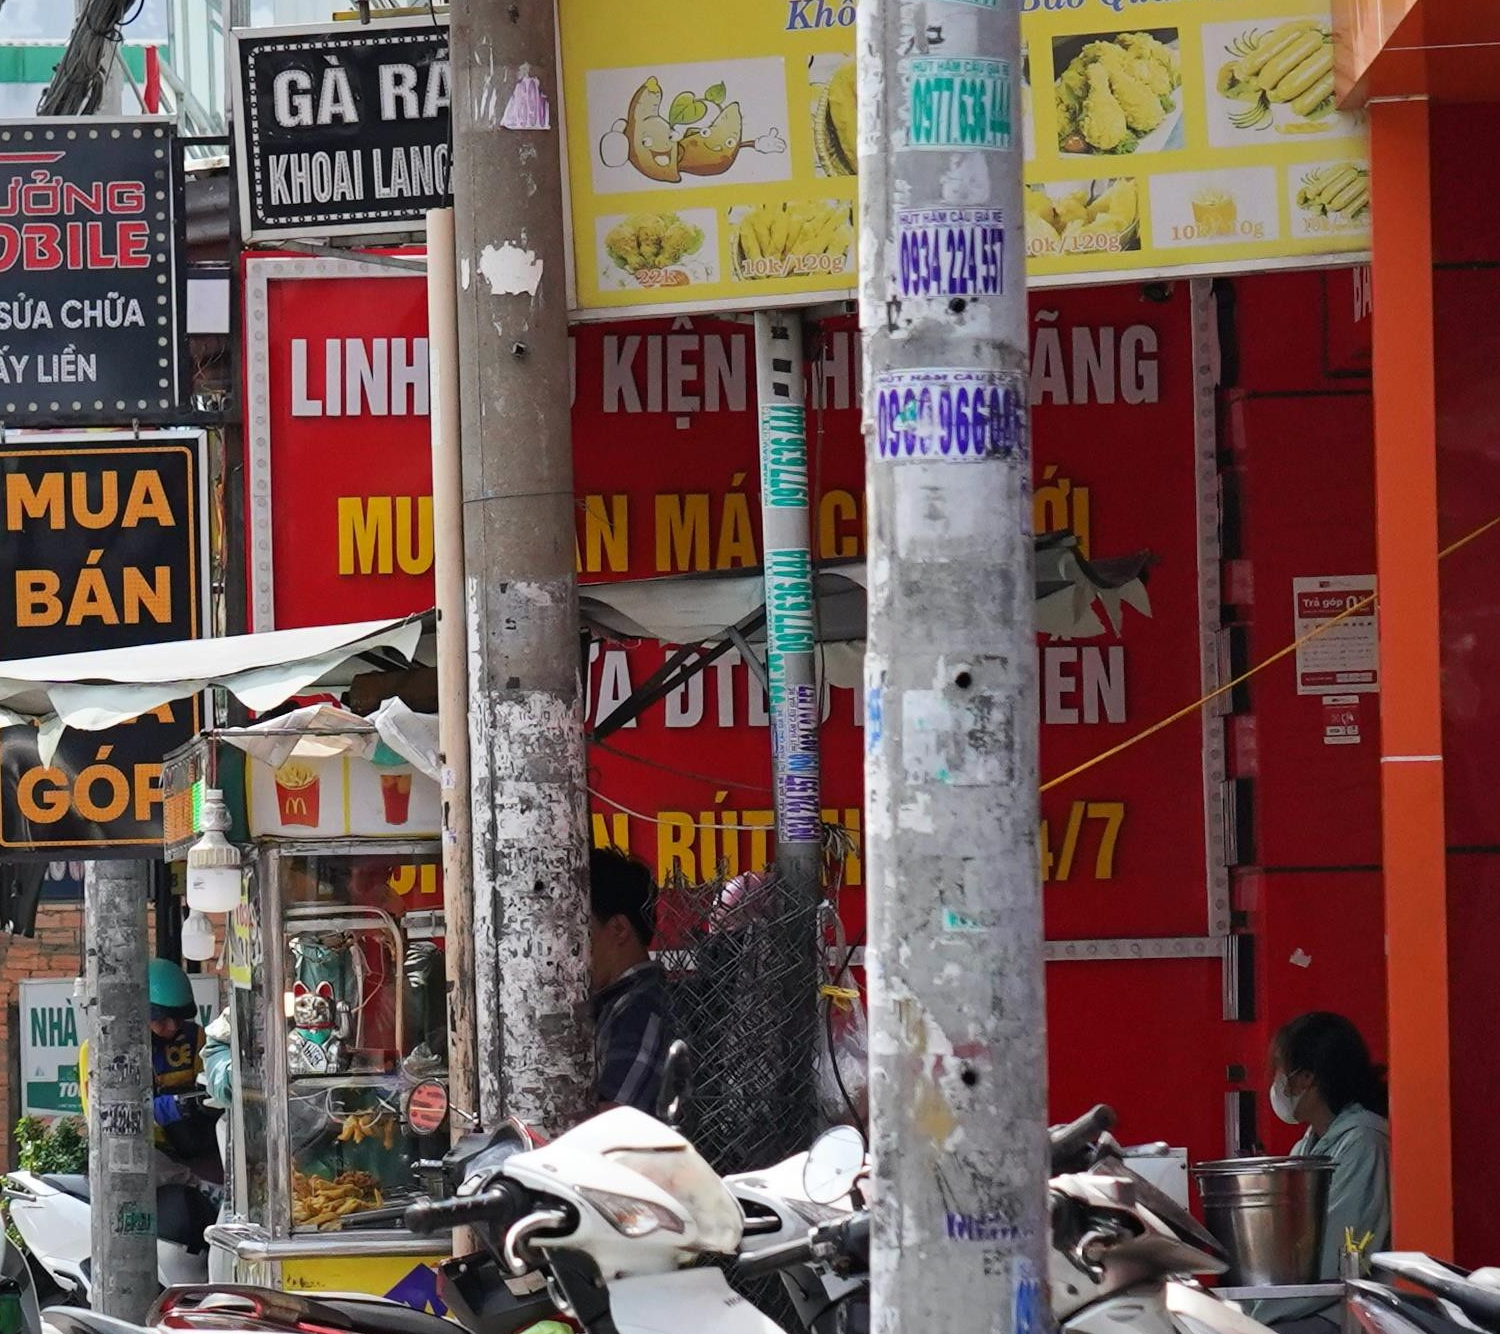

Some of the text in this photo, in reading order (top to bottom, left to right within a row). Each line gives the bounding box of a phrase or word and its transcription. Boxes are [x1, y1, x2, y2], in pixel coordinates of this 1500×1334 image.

[272, 47, 450, 128] GÀ RÁ
[268, 148, 365, 206] KHOAI
[636, 267, 679, 285] 22k
[60, 291, 146, 328] CHỮA
[37, 343, 98, 383] LIỀN
[290, 338, 432, 418] LINH
[602, 316, 748, 431] KIỆN
[1030, 308, 1160, 406] ÃNG
[5, 470, 176, 532] MUA
[655, 471, 758, 572] MÁ
[15, 550, 174, 628] BÁN
[1302, 596, 1344, 610] Trả góp
[16, 744, 165, 824] GÓP
[29, 998, 79, 1048] NHÀ
